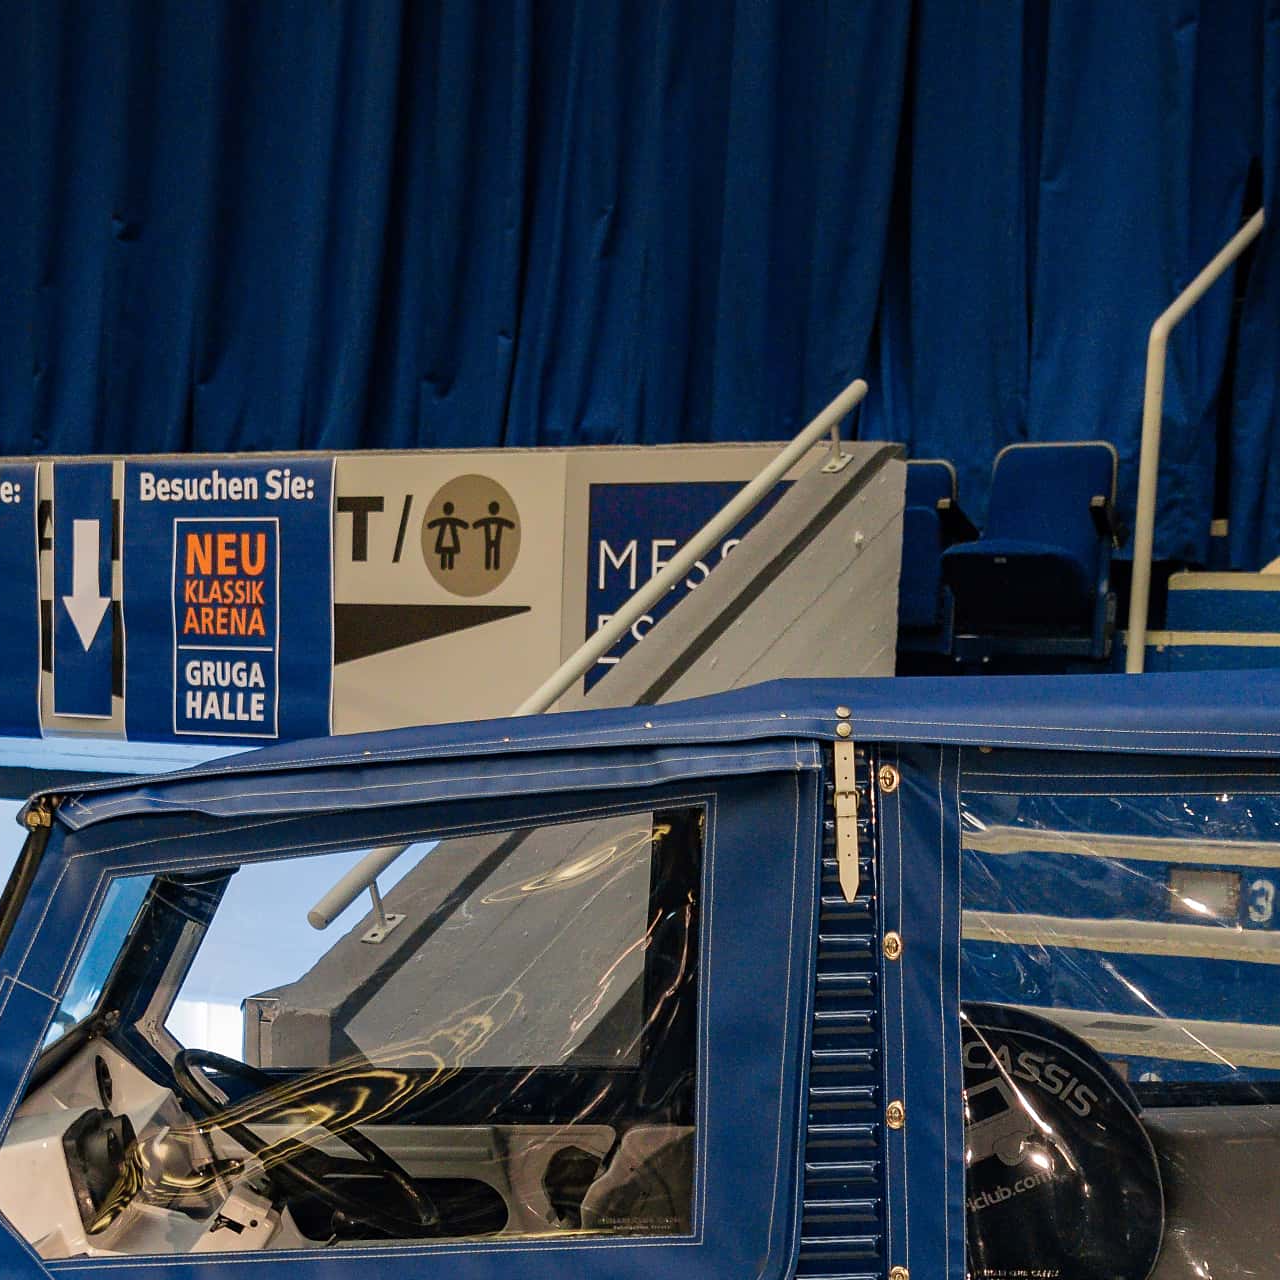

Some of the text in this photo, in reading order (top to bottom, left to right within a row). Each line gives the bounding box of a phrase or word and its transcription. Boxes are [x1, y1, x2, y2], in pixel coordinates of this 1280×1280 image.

[139, 469, 315, 501] Besuchen Sie:
[186, 533, 266, 576] NEU
[184, 579, 265, 604] KLASSIK
[183, 607, 266, 636] ARENA
[185, 660, 266, 688] GRUGA
[185, 690, 265, 721] HALLE
[1248, 879, 1275, 922] 3
[962, 1041, 1098, 1117] CASSIS
